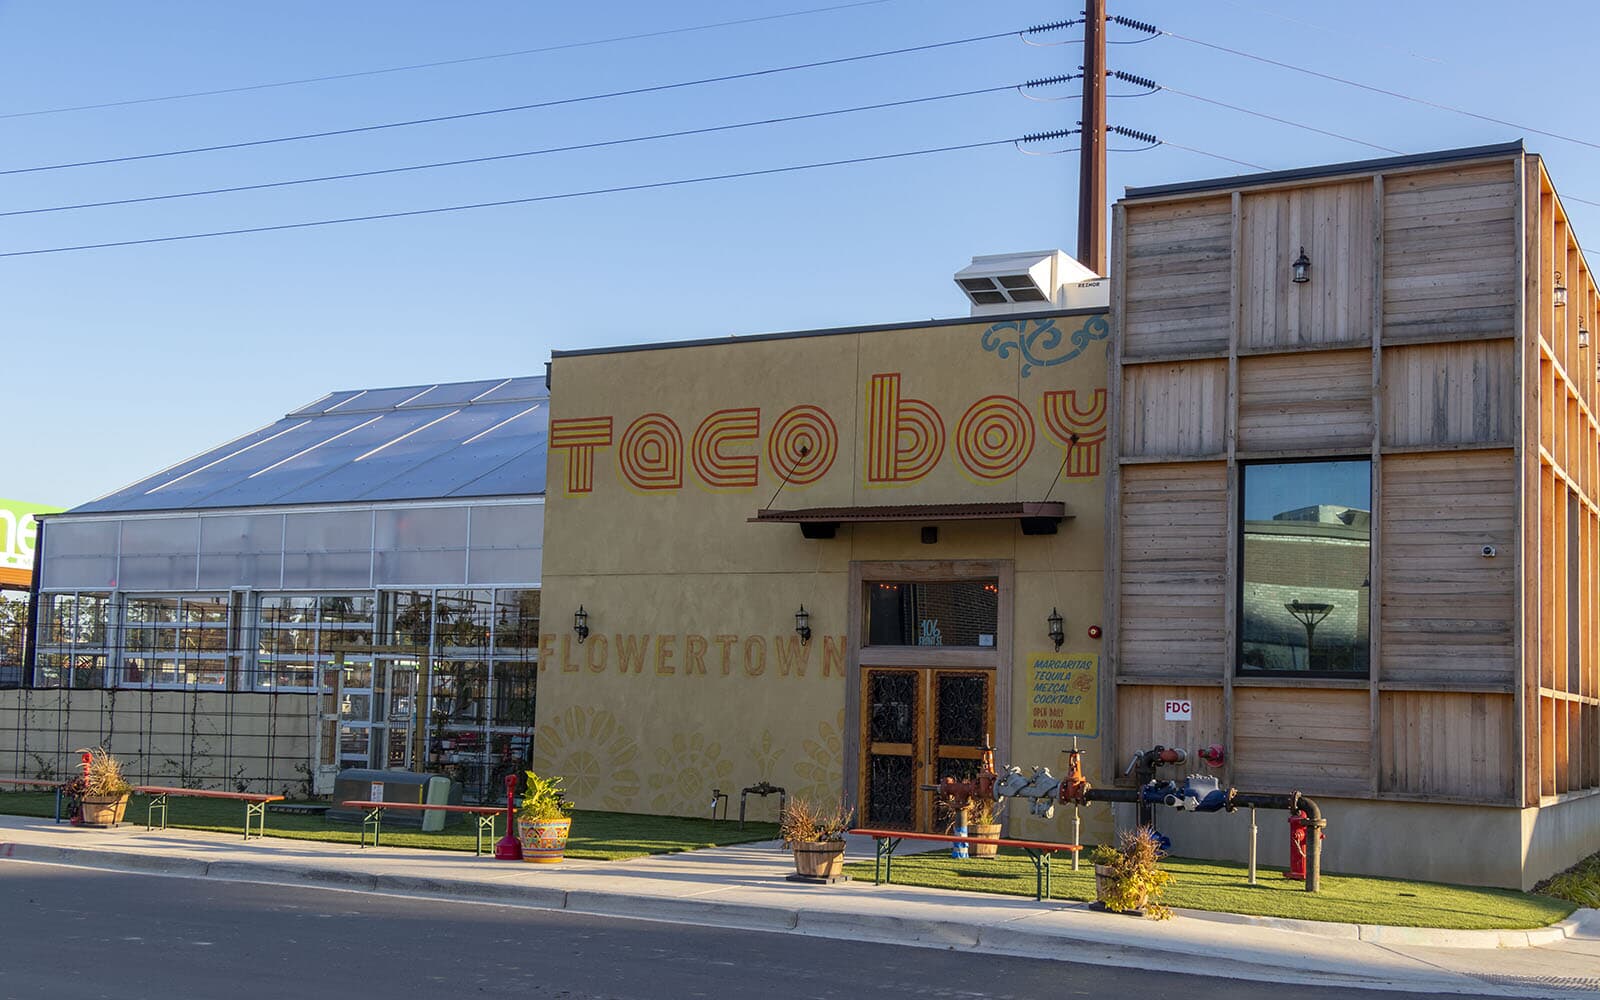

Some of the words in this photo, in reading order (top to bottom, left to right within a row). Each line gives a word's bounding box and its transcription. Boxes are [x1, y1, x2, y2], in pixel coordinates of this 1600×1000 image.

[920, 618, 941, 637] 106
[538, 633, 847, 677] FLOWERTOWN
[1034, 660, 1092, 670] MARGARITAS
[1035, 671, 1072, 681] TEQUILA
[1034, 695, 1082, 705] COCKTAILS
[1033, 707, 1048, 717] OPEN
[1166, 702, 1190, 713] FDC
